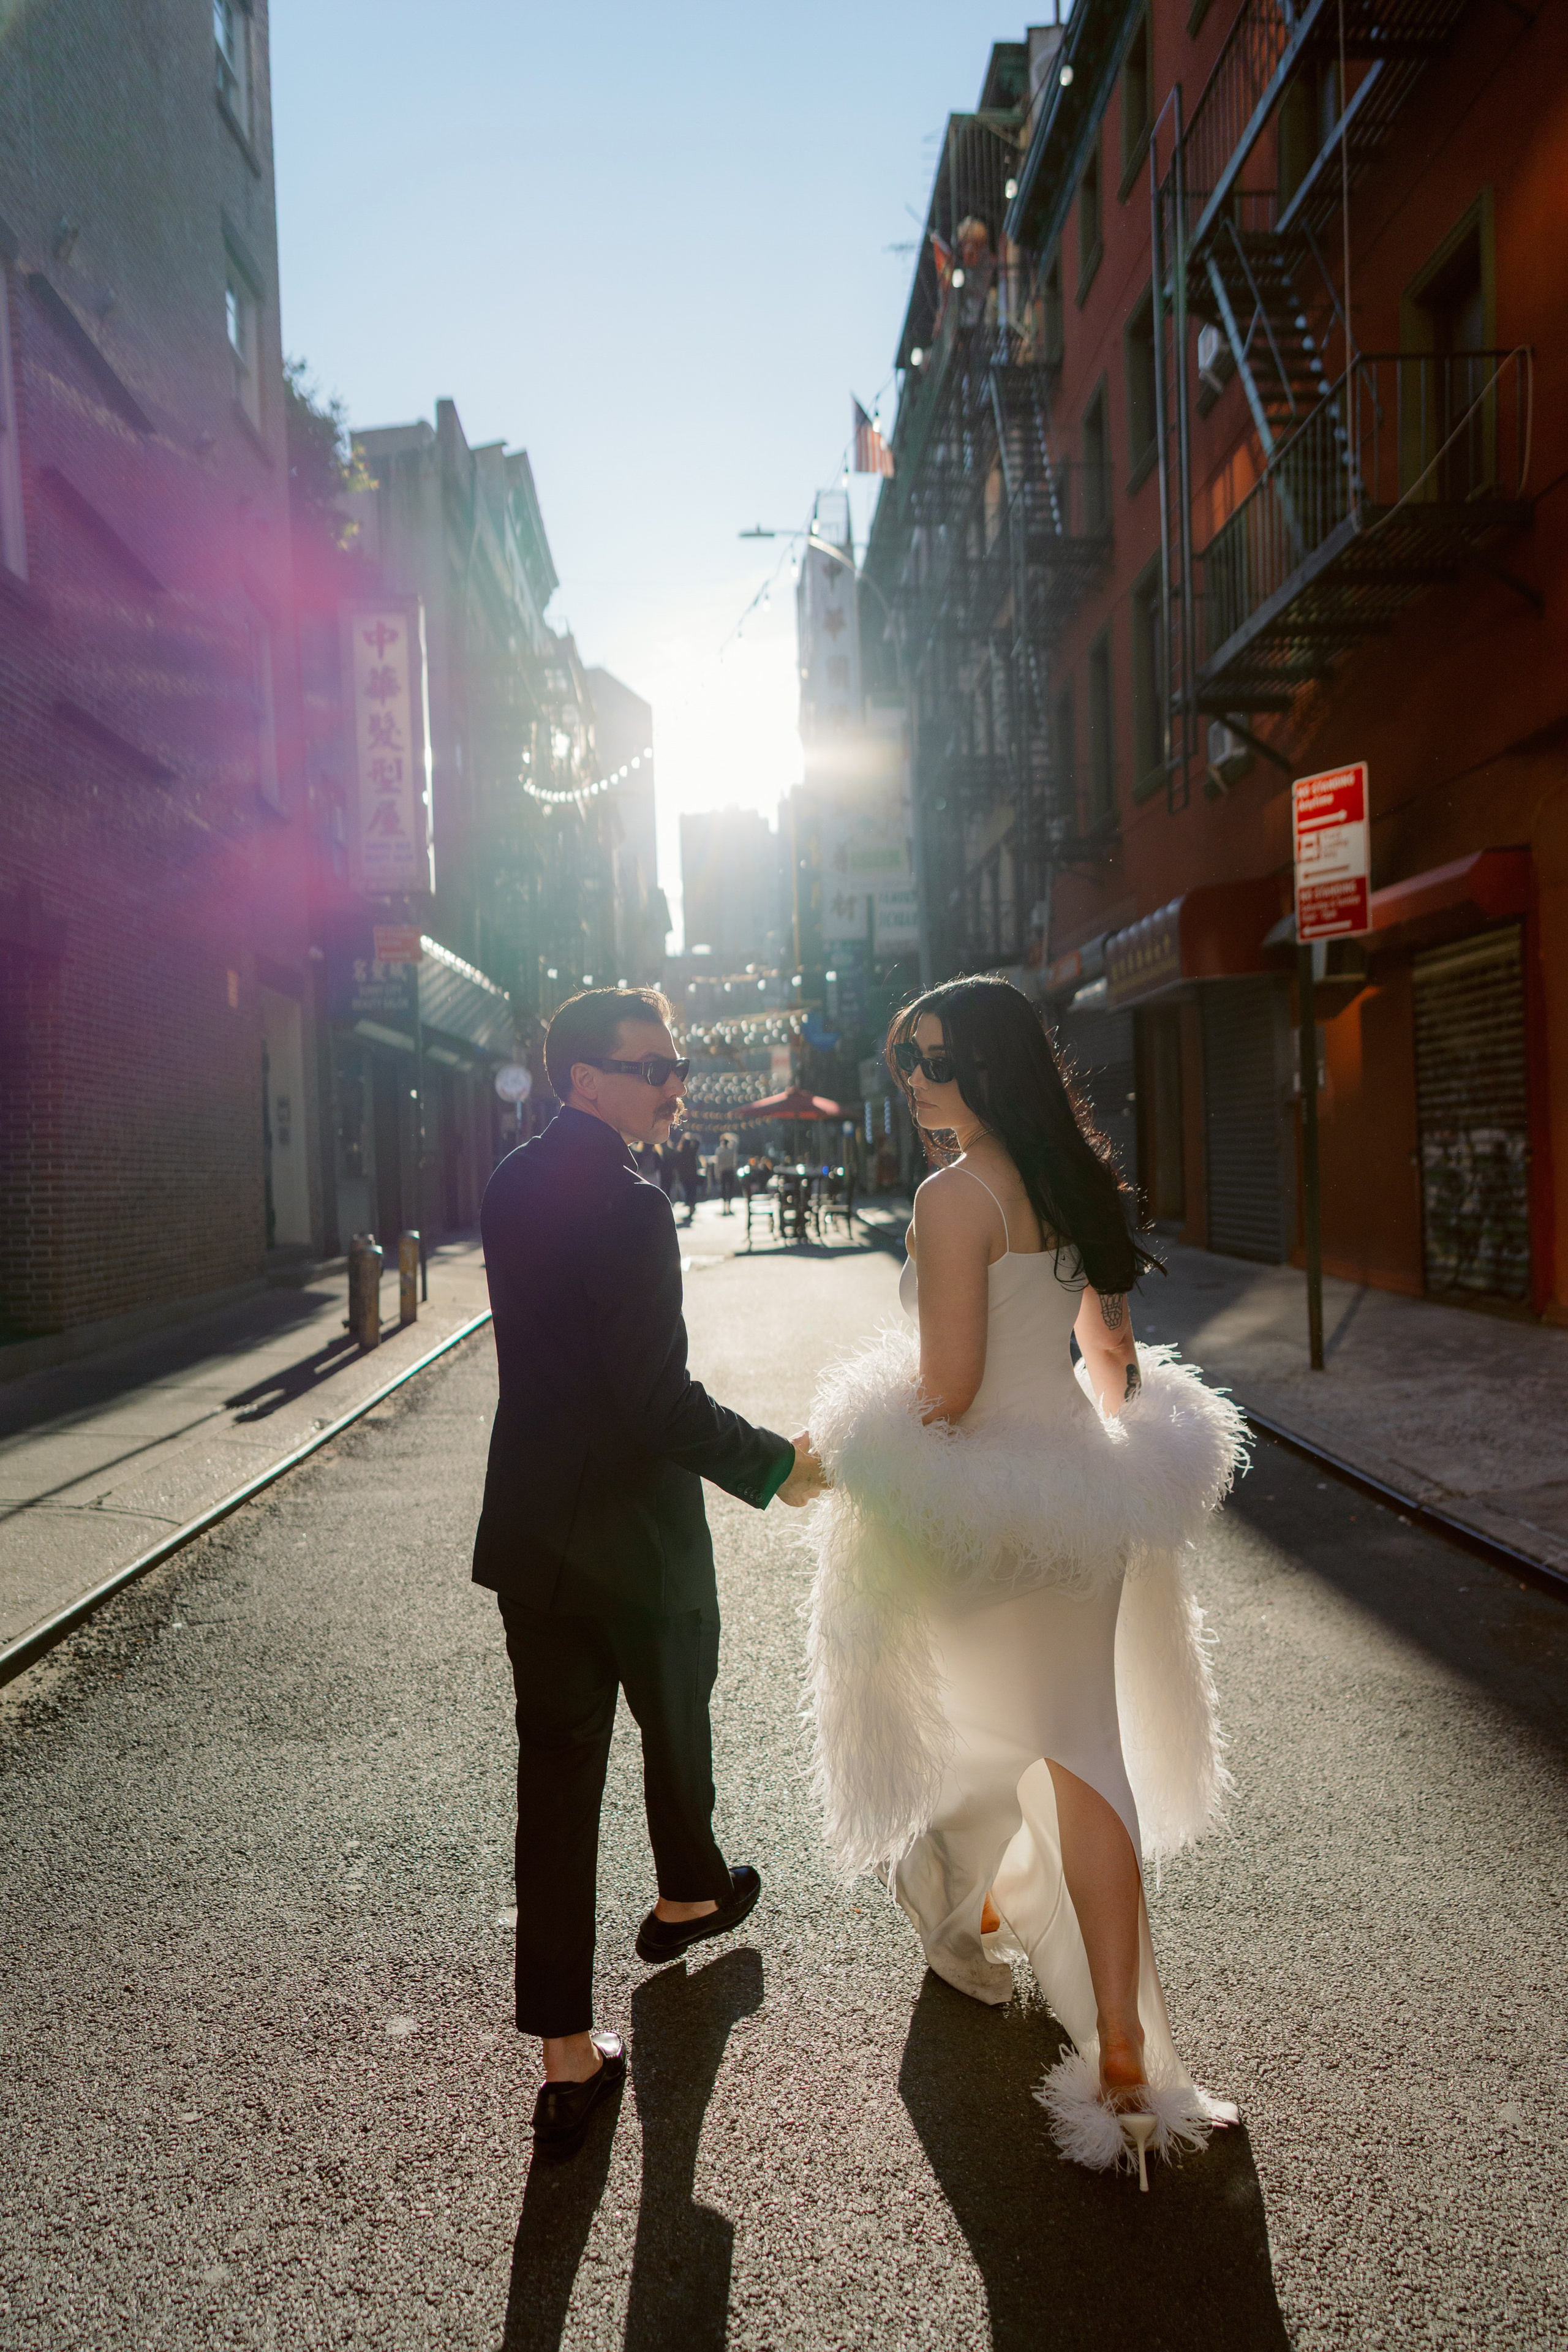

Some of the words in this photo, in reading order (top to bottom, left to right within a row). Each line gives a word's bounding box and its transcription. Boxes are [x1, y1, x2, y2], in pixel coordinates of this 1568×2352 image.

[1297, 784, 1310, 799] NO
[1312, 771, 1355, 794] STANDING
[1298, 793, 1334, 813] Anytime
[1300, 888, 1312, 902] NO
[1314, 880, 1357, 899] STANDING
